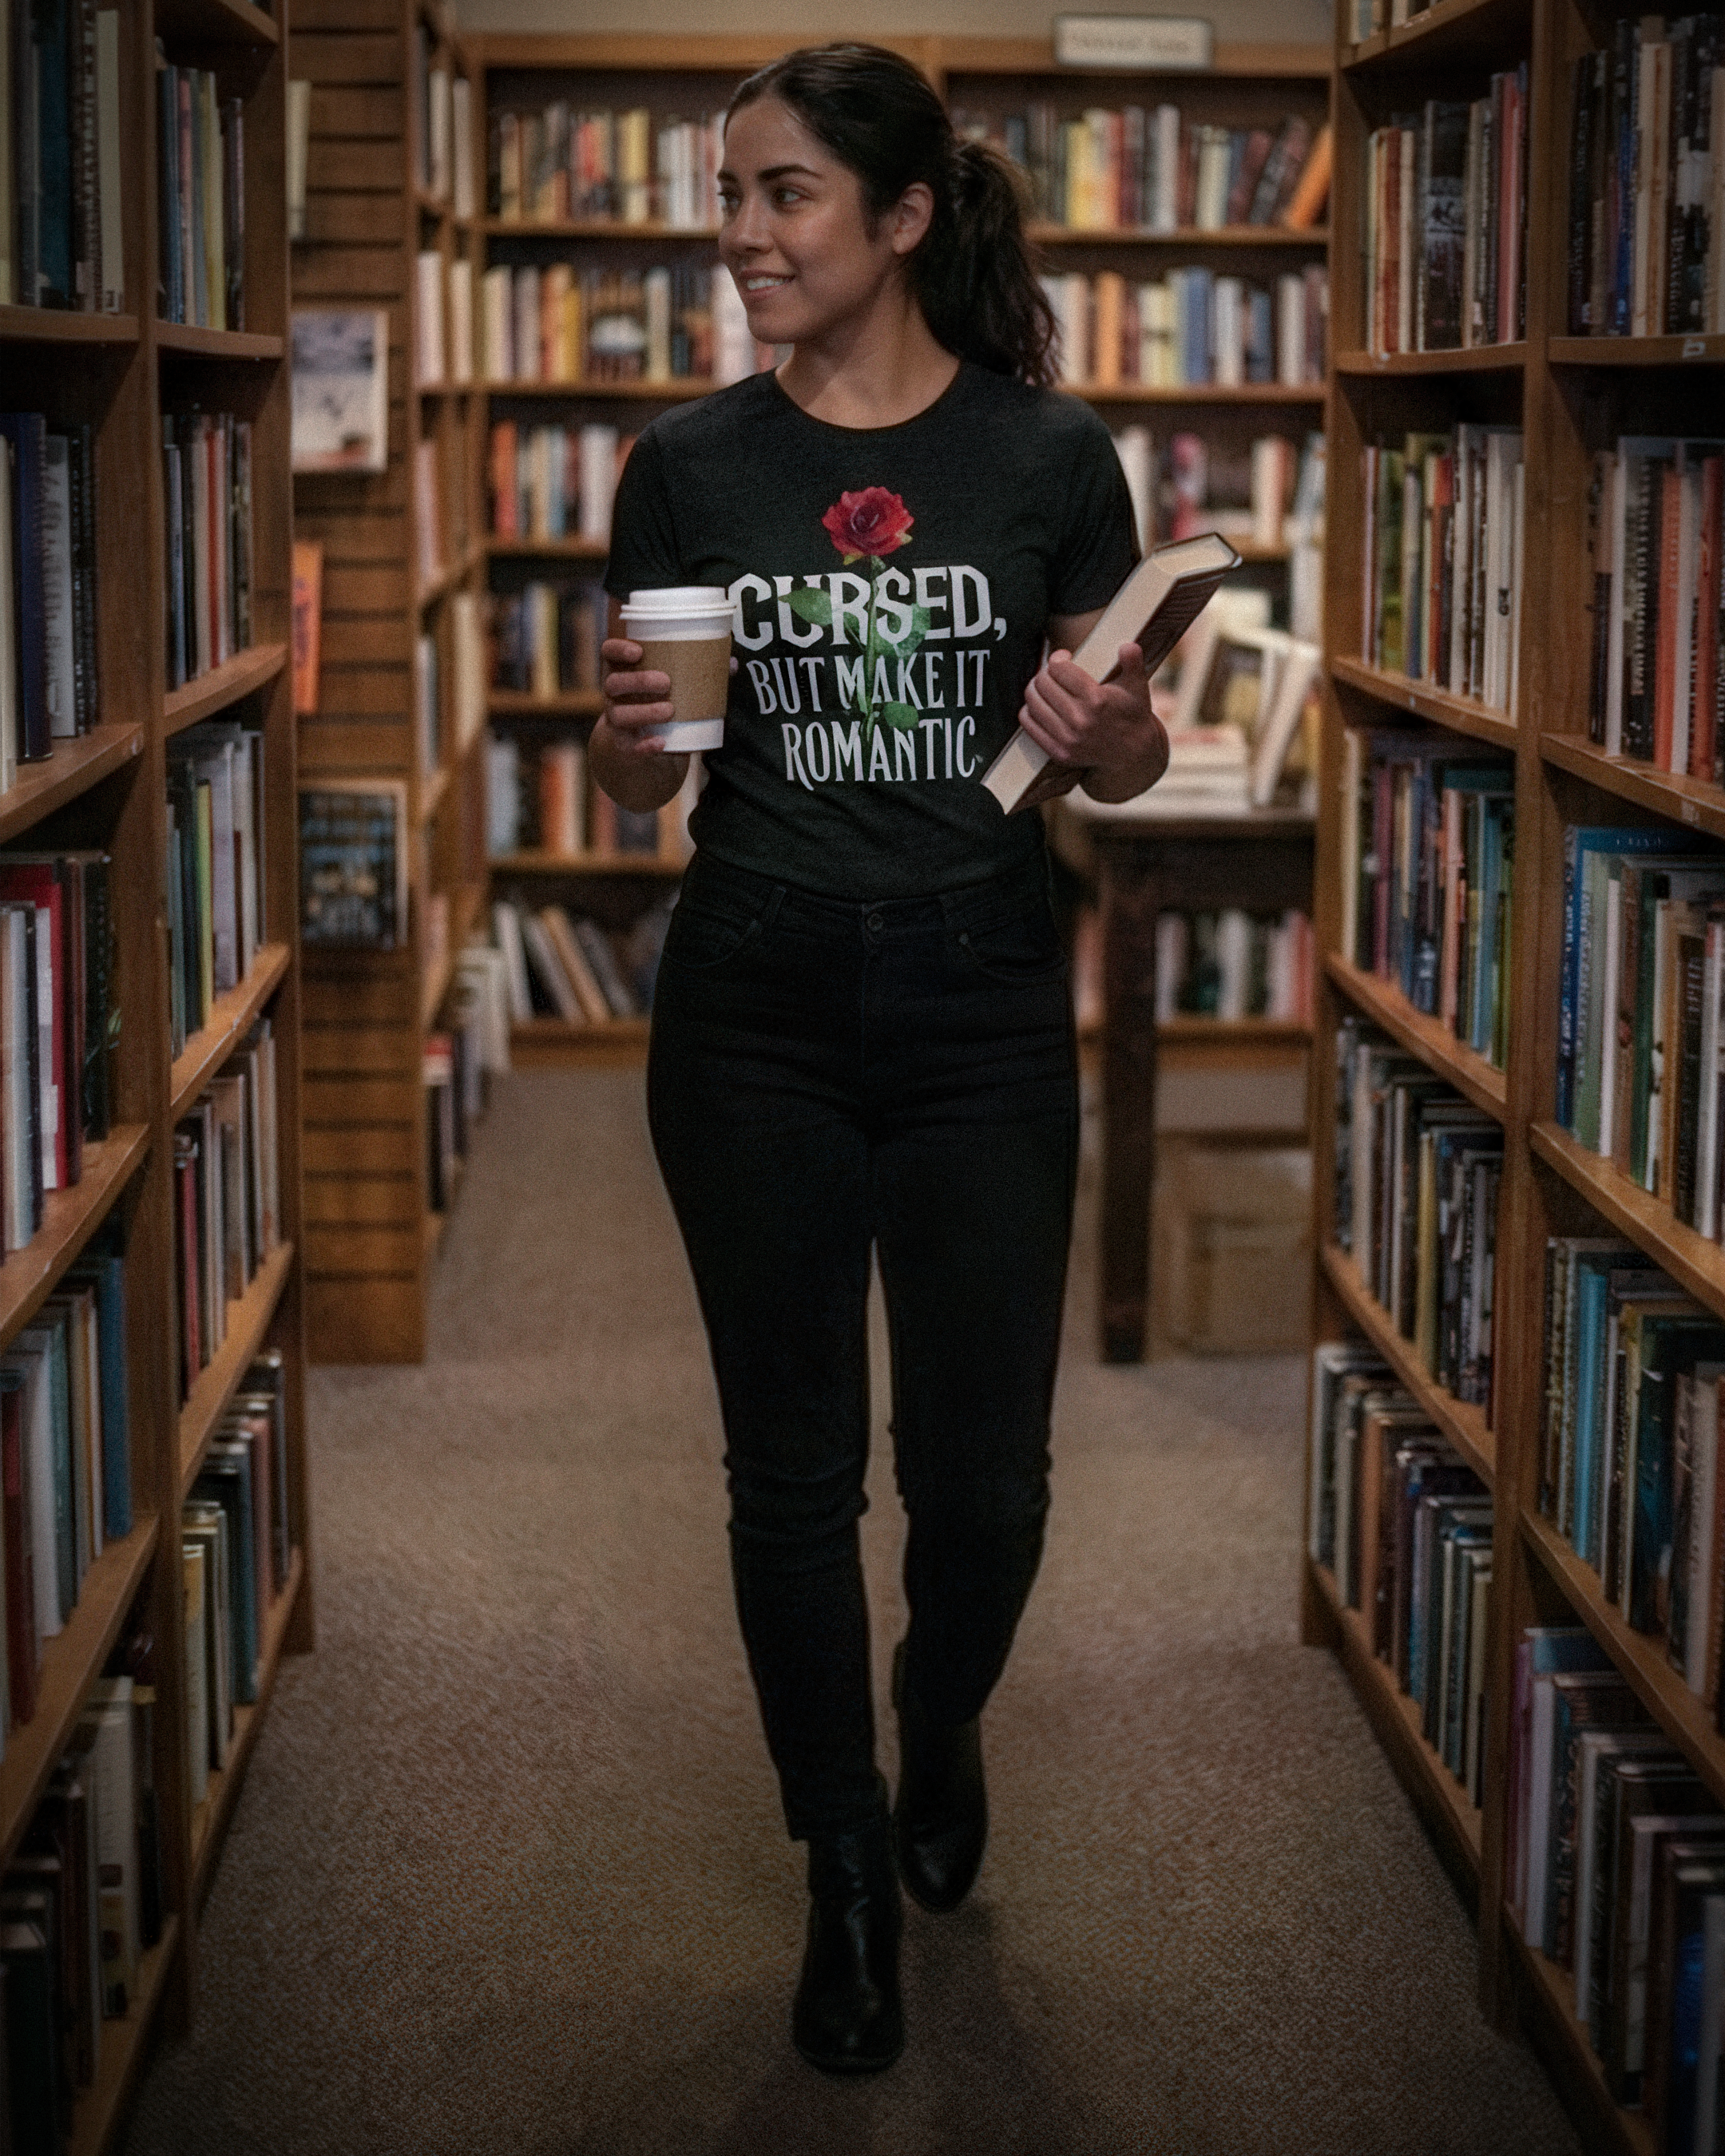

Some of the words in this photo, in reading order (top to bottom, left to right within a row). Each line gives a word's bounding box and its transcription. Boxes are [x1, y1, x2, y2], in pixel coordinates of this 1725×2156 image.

[728, 565, 1007, 652] CURSED,
[746, 656, 825, 715] BUT
[835, 651, 945, 715] MAKE
[956, 649, 990, 707] IT
